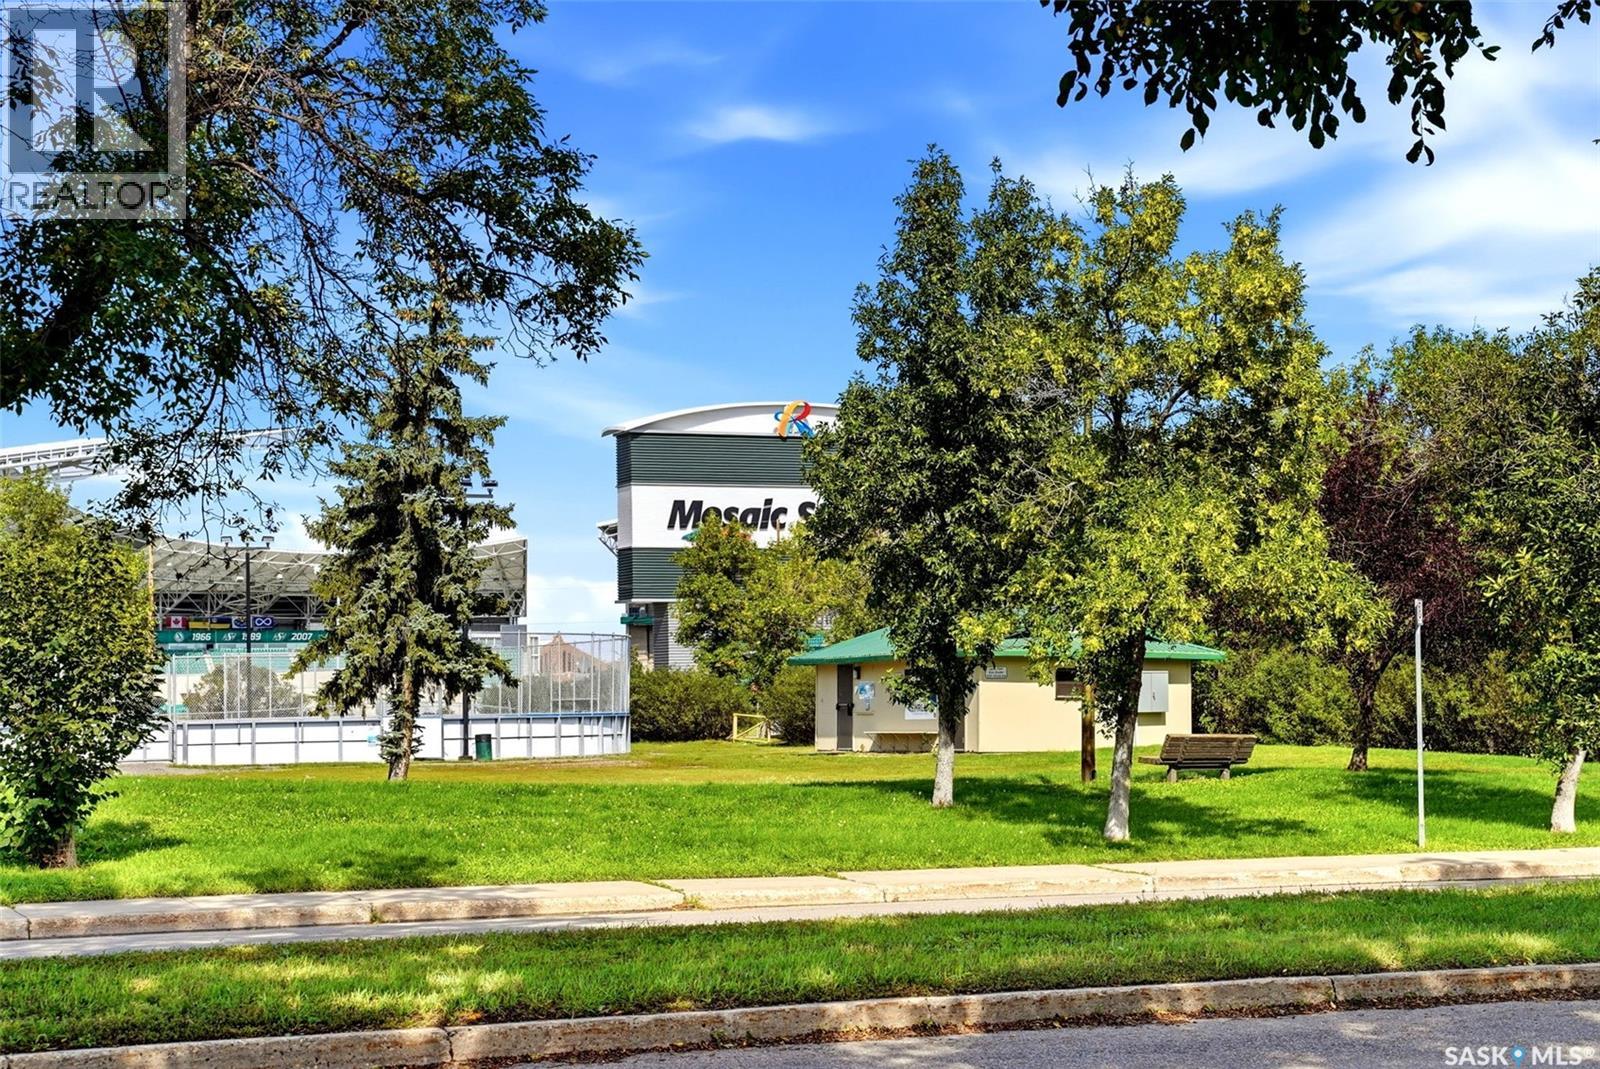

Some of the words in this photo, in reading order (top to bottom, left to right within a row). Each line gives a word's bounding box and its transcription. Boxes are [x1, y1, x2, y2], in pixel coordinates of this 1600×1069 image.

[667, 498, 788, 530] Mosaic
[192, 632, 212, 641] 1966
[242, 632, 262, 641] 189
[291, 632, 314, 641] 2007
